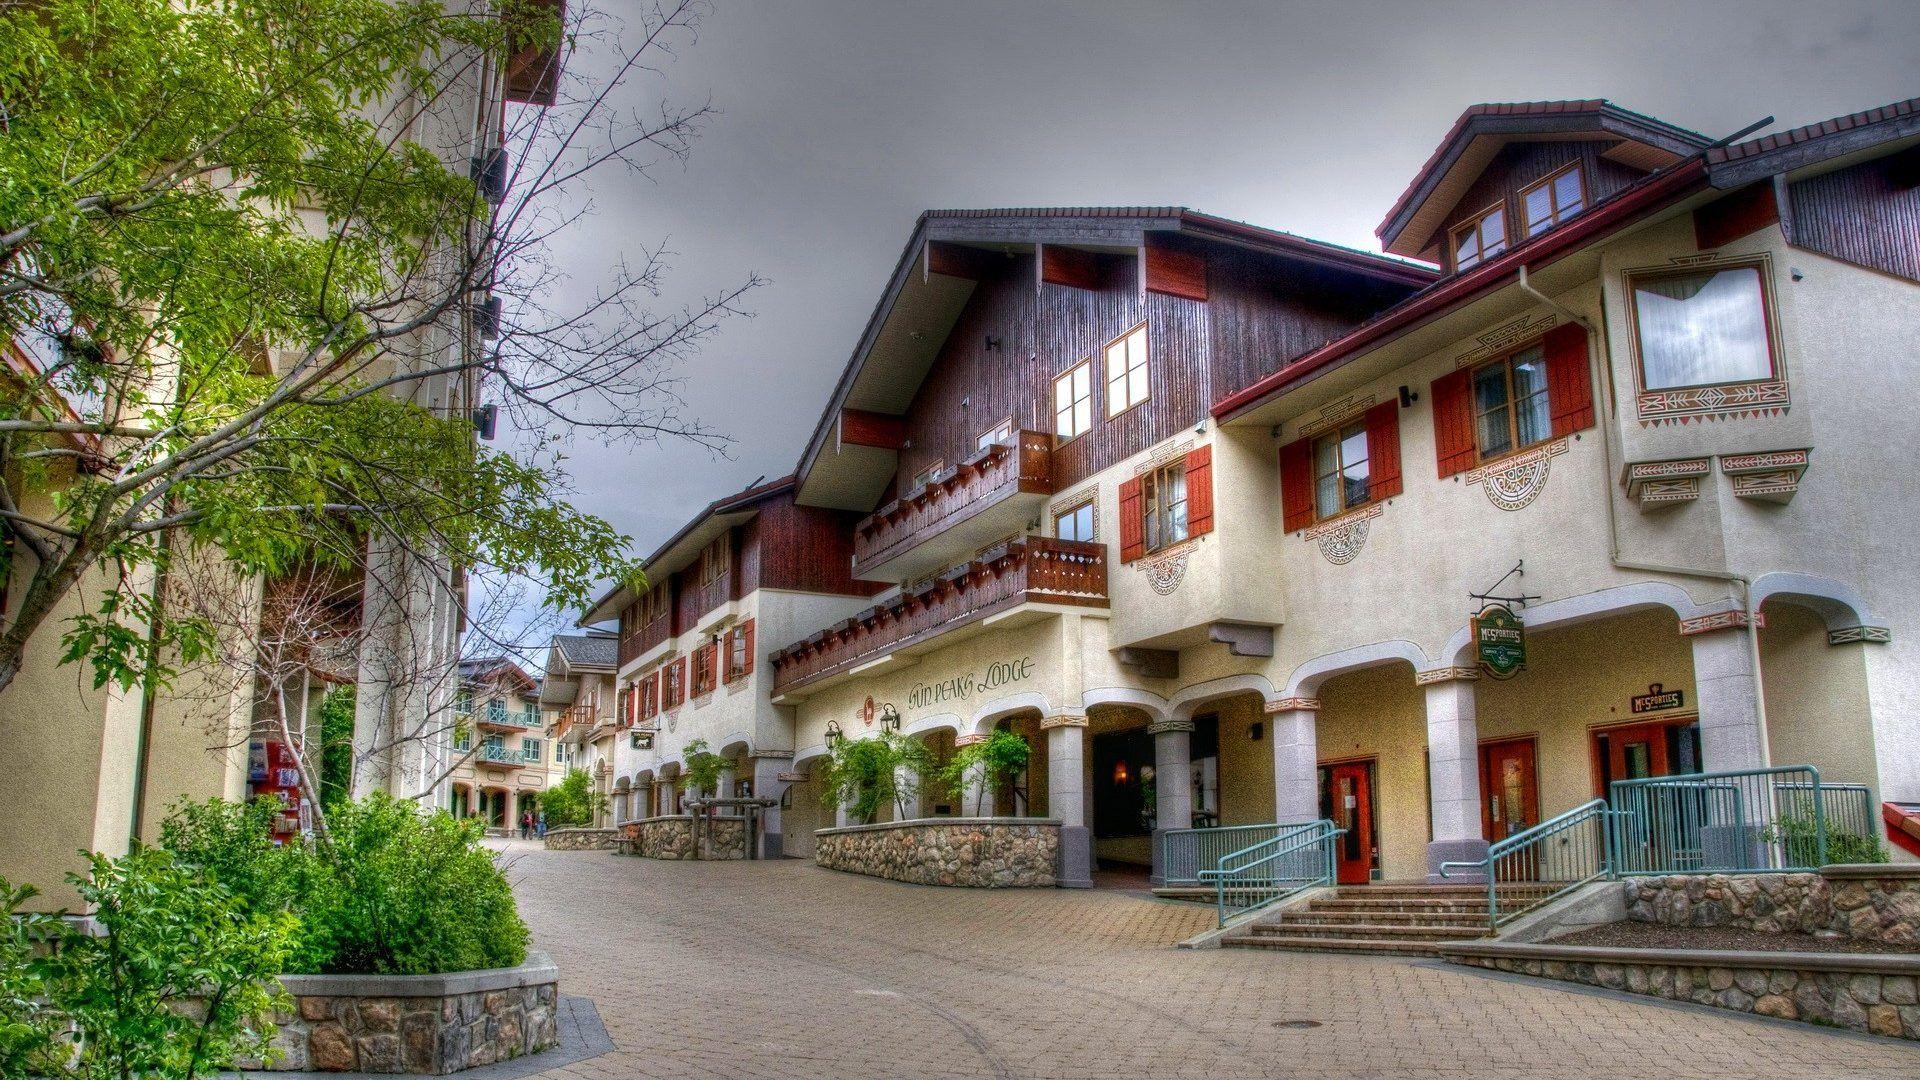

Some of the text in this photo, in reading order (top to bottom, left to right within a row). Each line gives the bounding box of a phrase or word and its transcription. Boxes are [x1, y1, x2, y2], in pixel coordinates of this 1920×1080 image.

[908, 657, 1035, 710] SUN PEAKS LODGE
